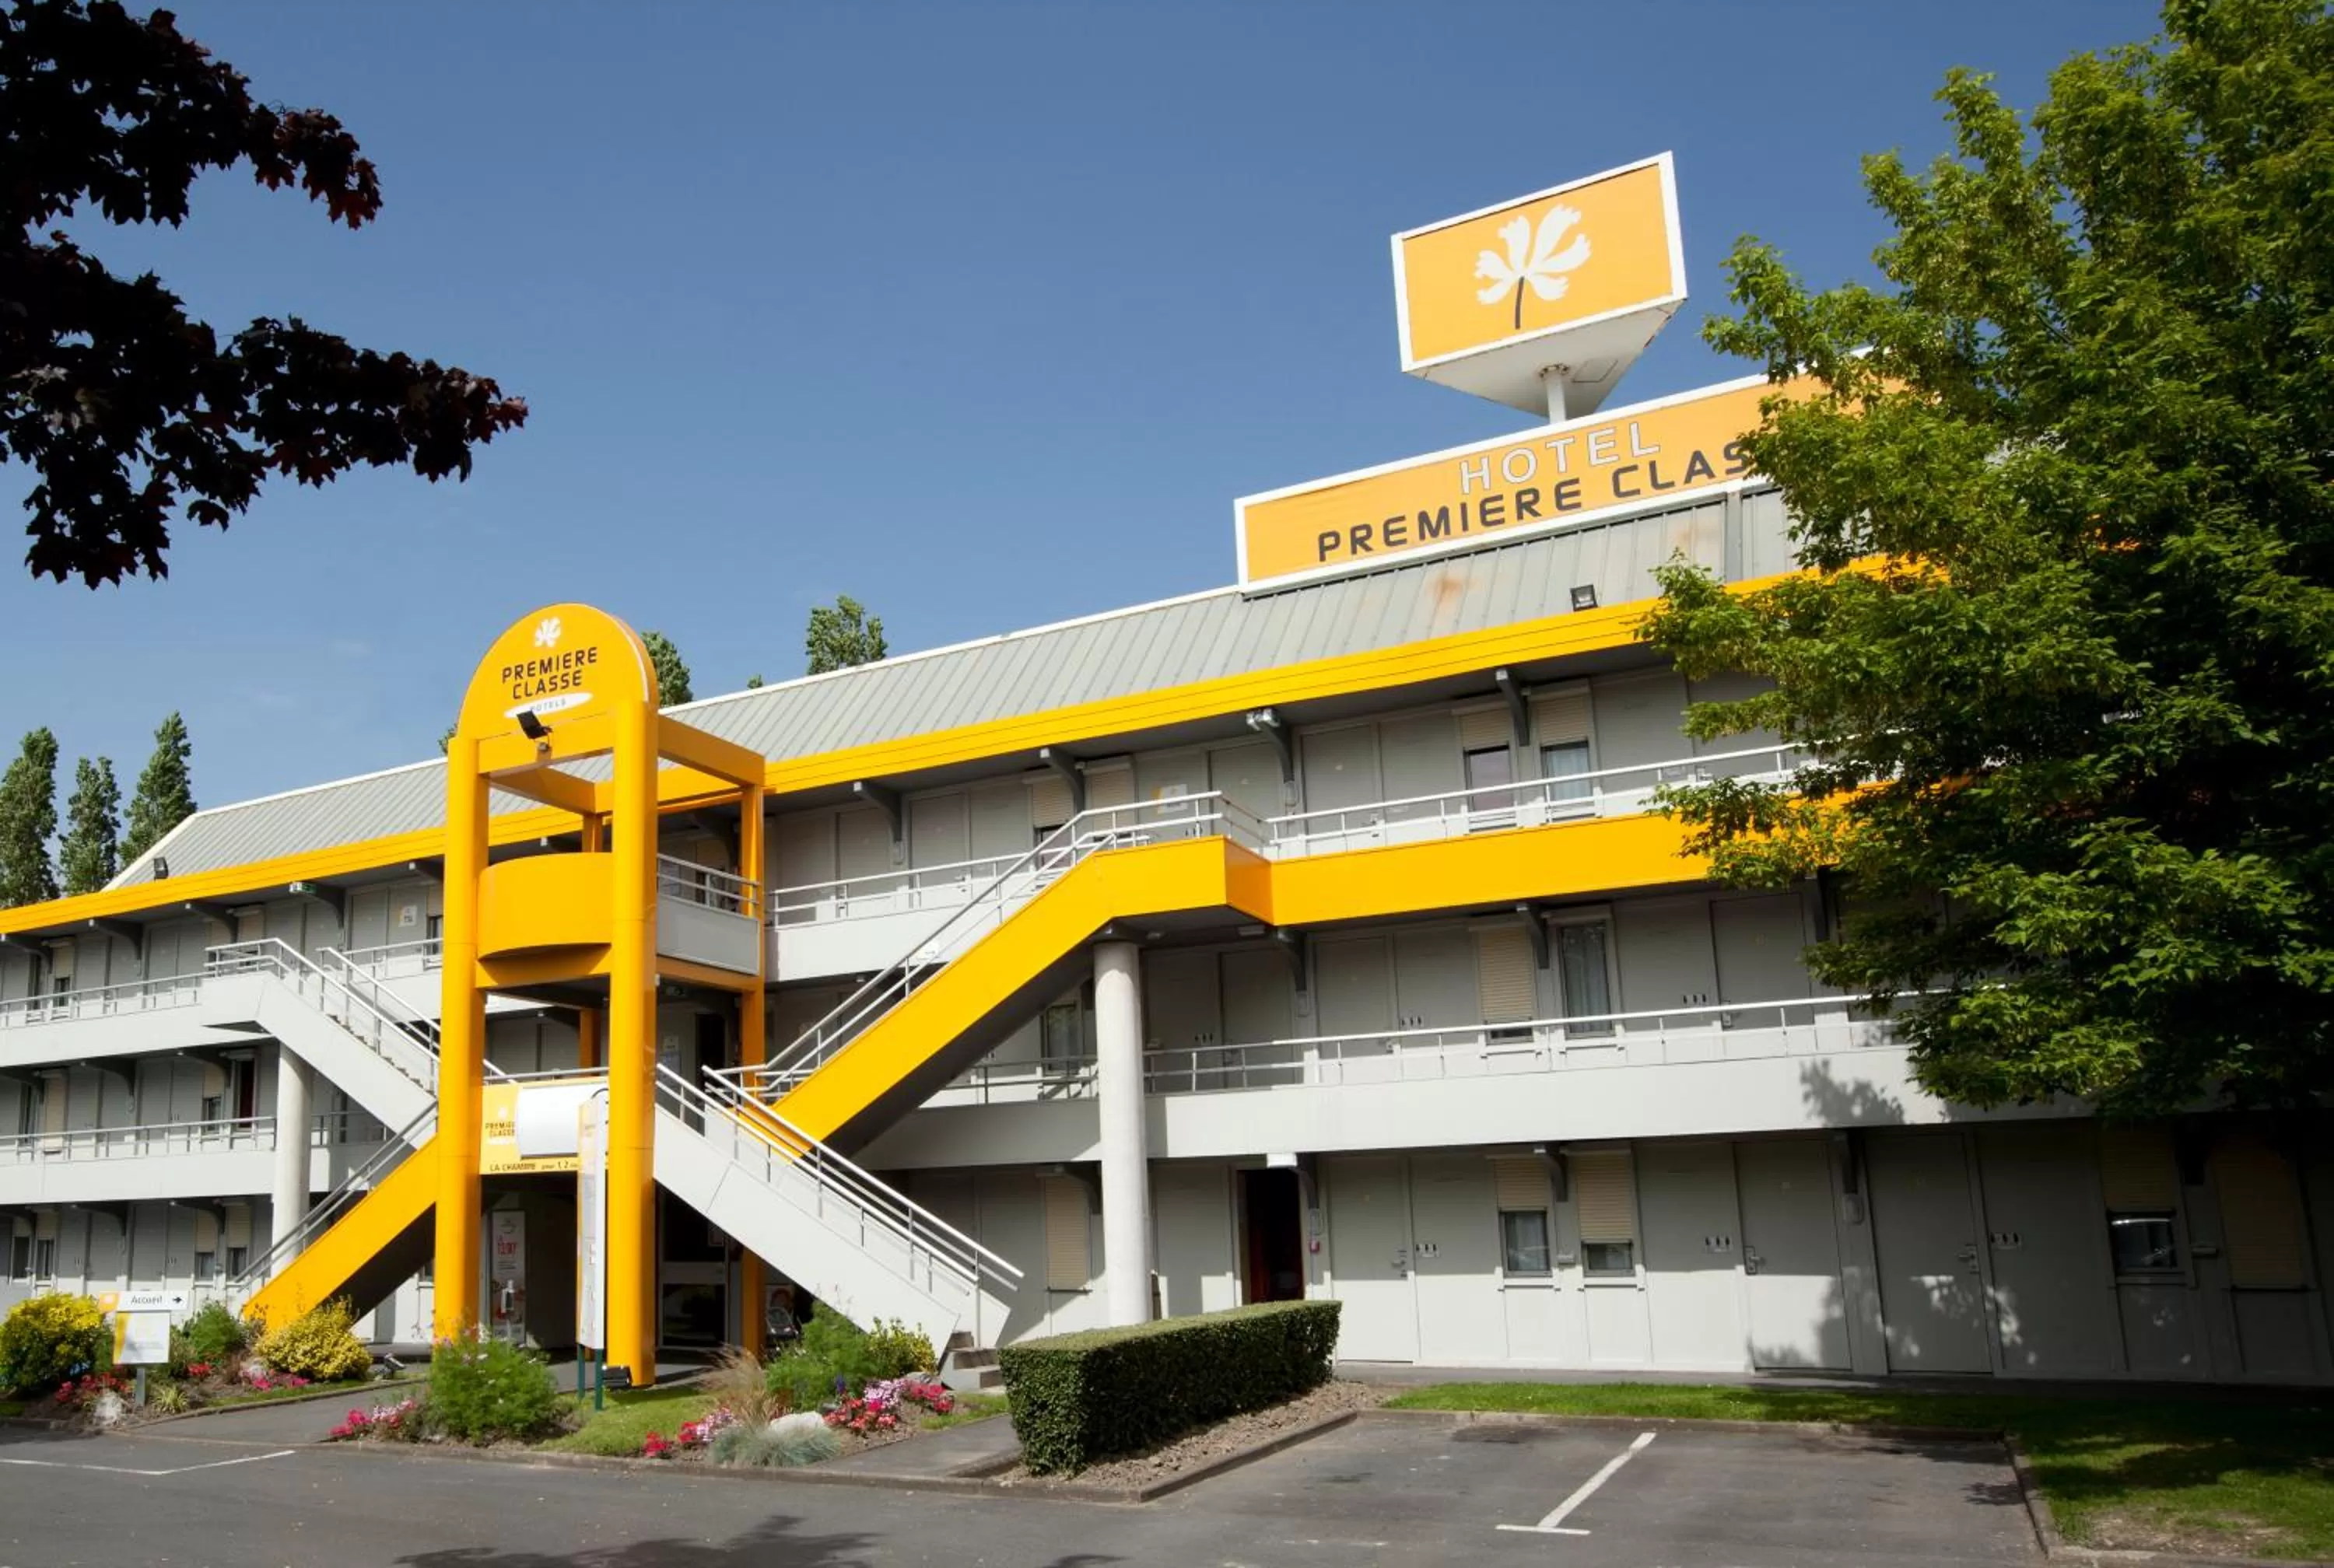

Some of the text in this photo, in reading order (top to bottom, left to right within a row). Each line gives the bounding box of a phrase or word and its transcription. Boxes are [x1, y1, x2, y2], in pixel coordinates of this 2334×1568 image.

[1460, 422, 1660, 495] HOTEL
[1318, 441, 1749, 562] PREMIERE CLAS
[502, 646, 598, 684] PREMIERE
[513, 670, 582, 699] CLASSE
[489, 1164, 500, 1172] LA
[130, 1294, 163, 1305] Accueil
